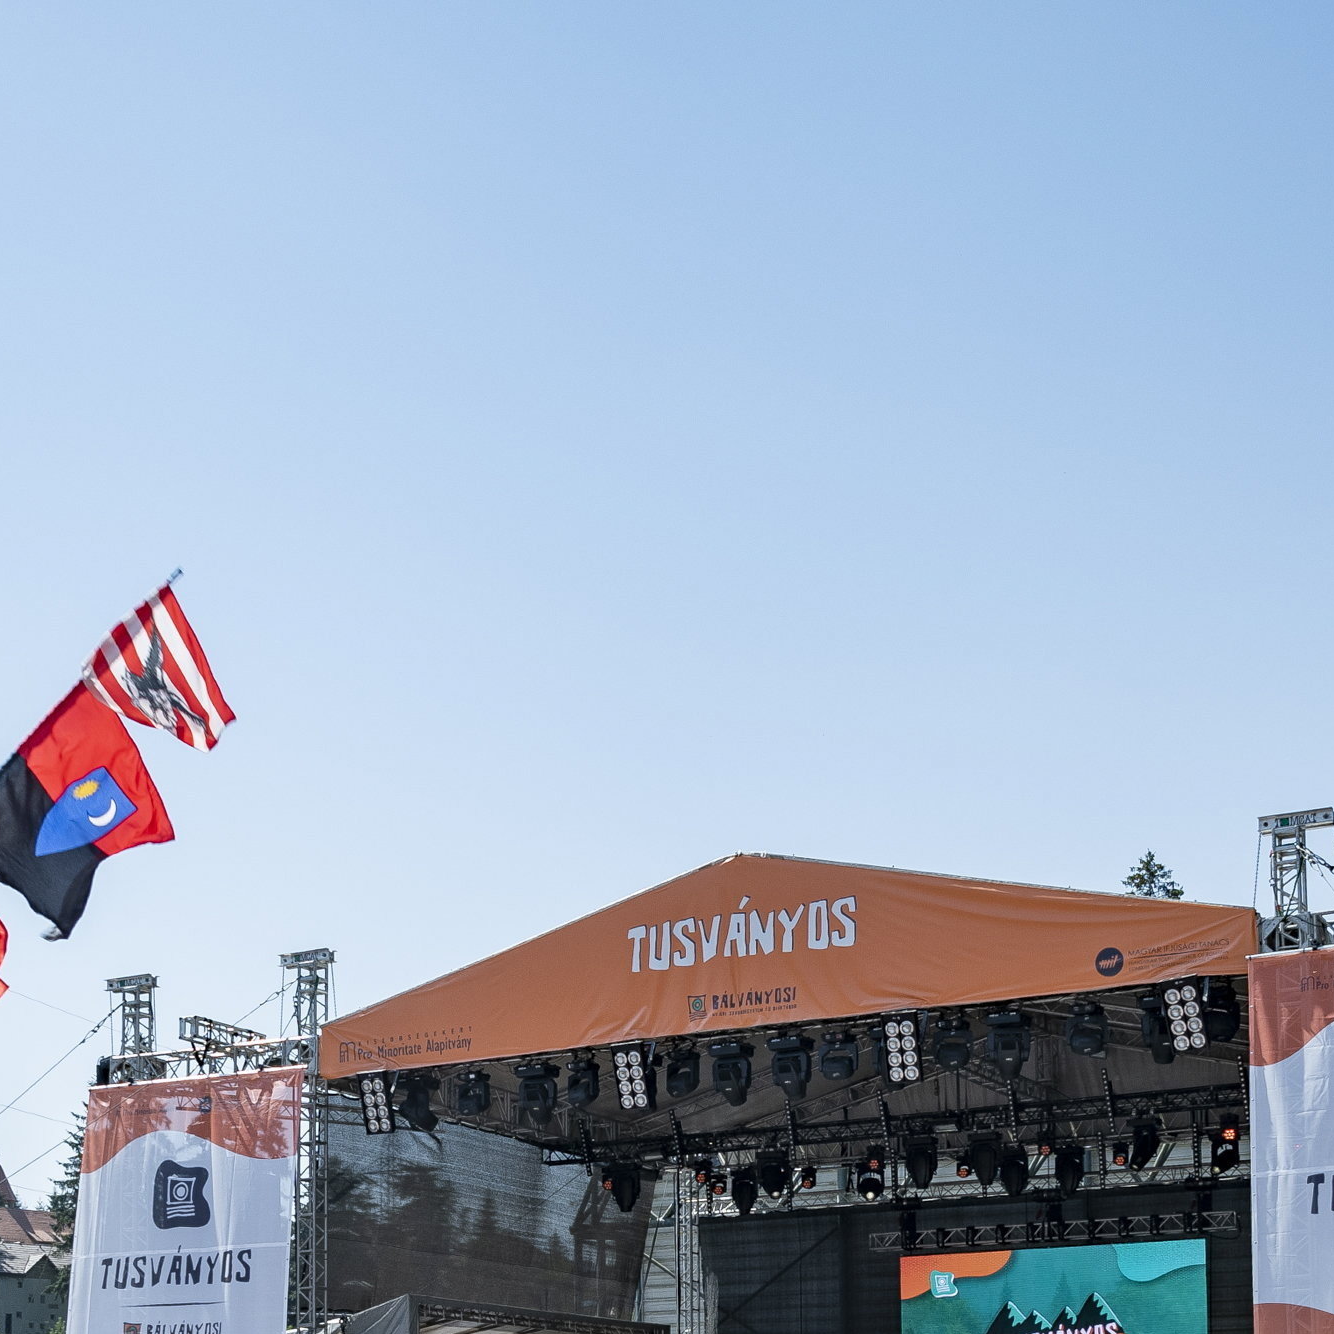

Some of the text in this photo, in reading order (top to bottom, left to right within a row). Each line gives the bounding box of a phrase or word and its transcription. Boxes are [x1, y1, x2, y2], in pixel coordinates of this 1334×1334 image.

[627, 895, 857, 973] TUSVÁNYOS
[712, 986, 797, 1010] BÁLVÁNYOSI
[357, 1035, 472, 1061] Pro Minoritate Alapítvány
[101, 1244, 252, 1290] TUSVÁNYOS
